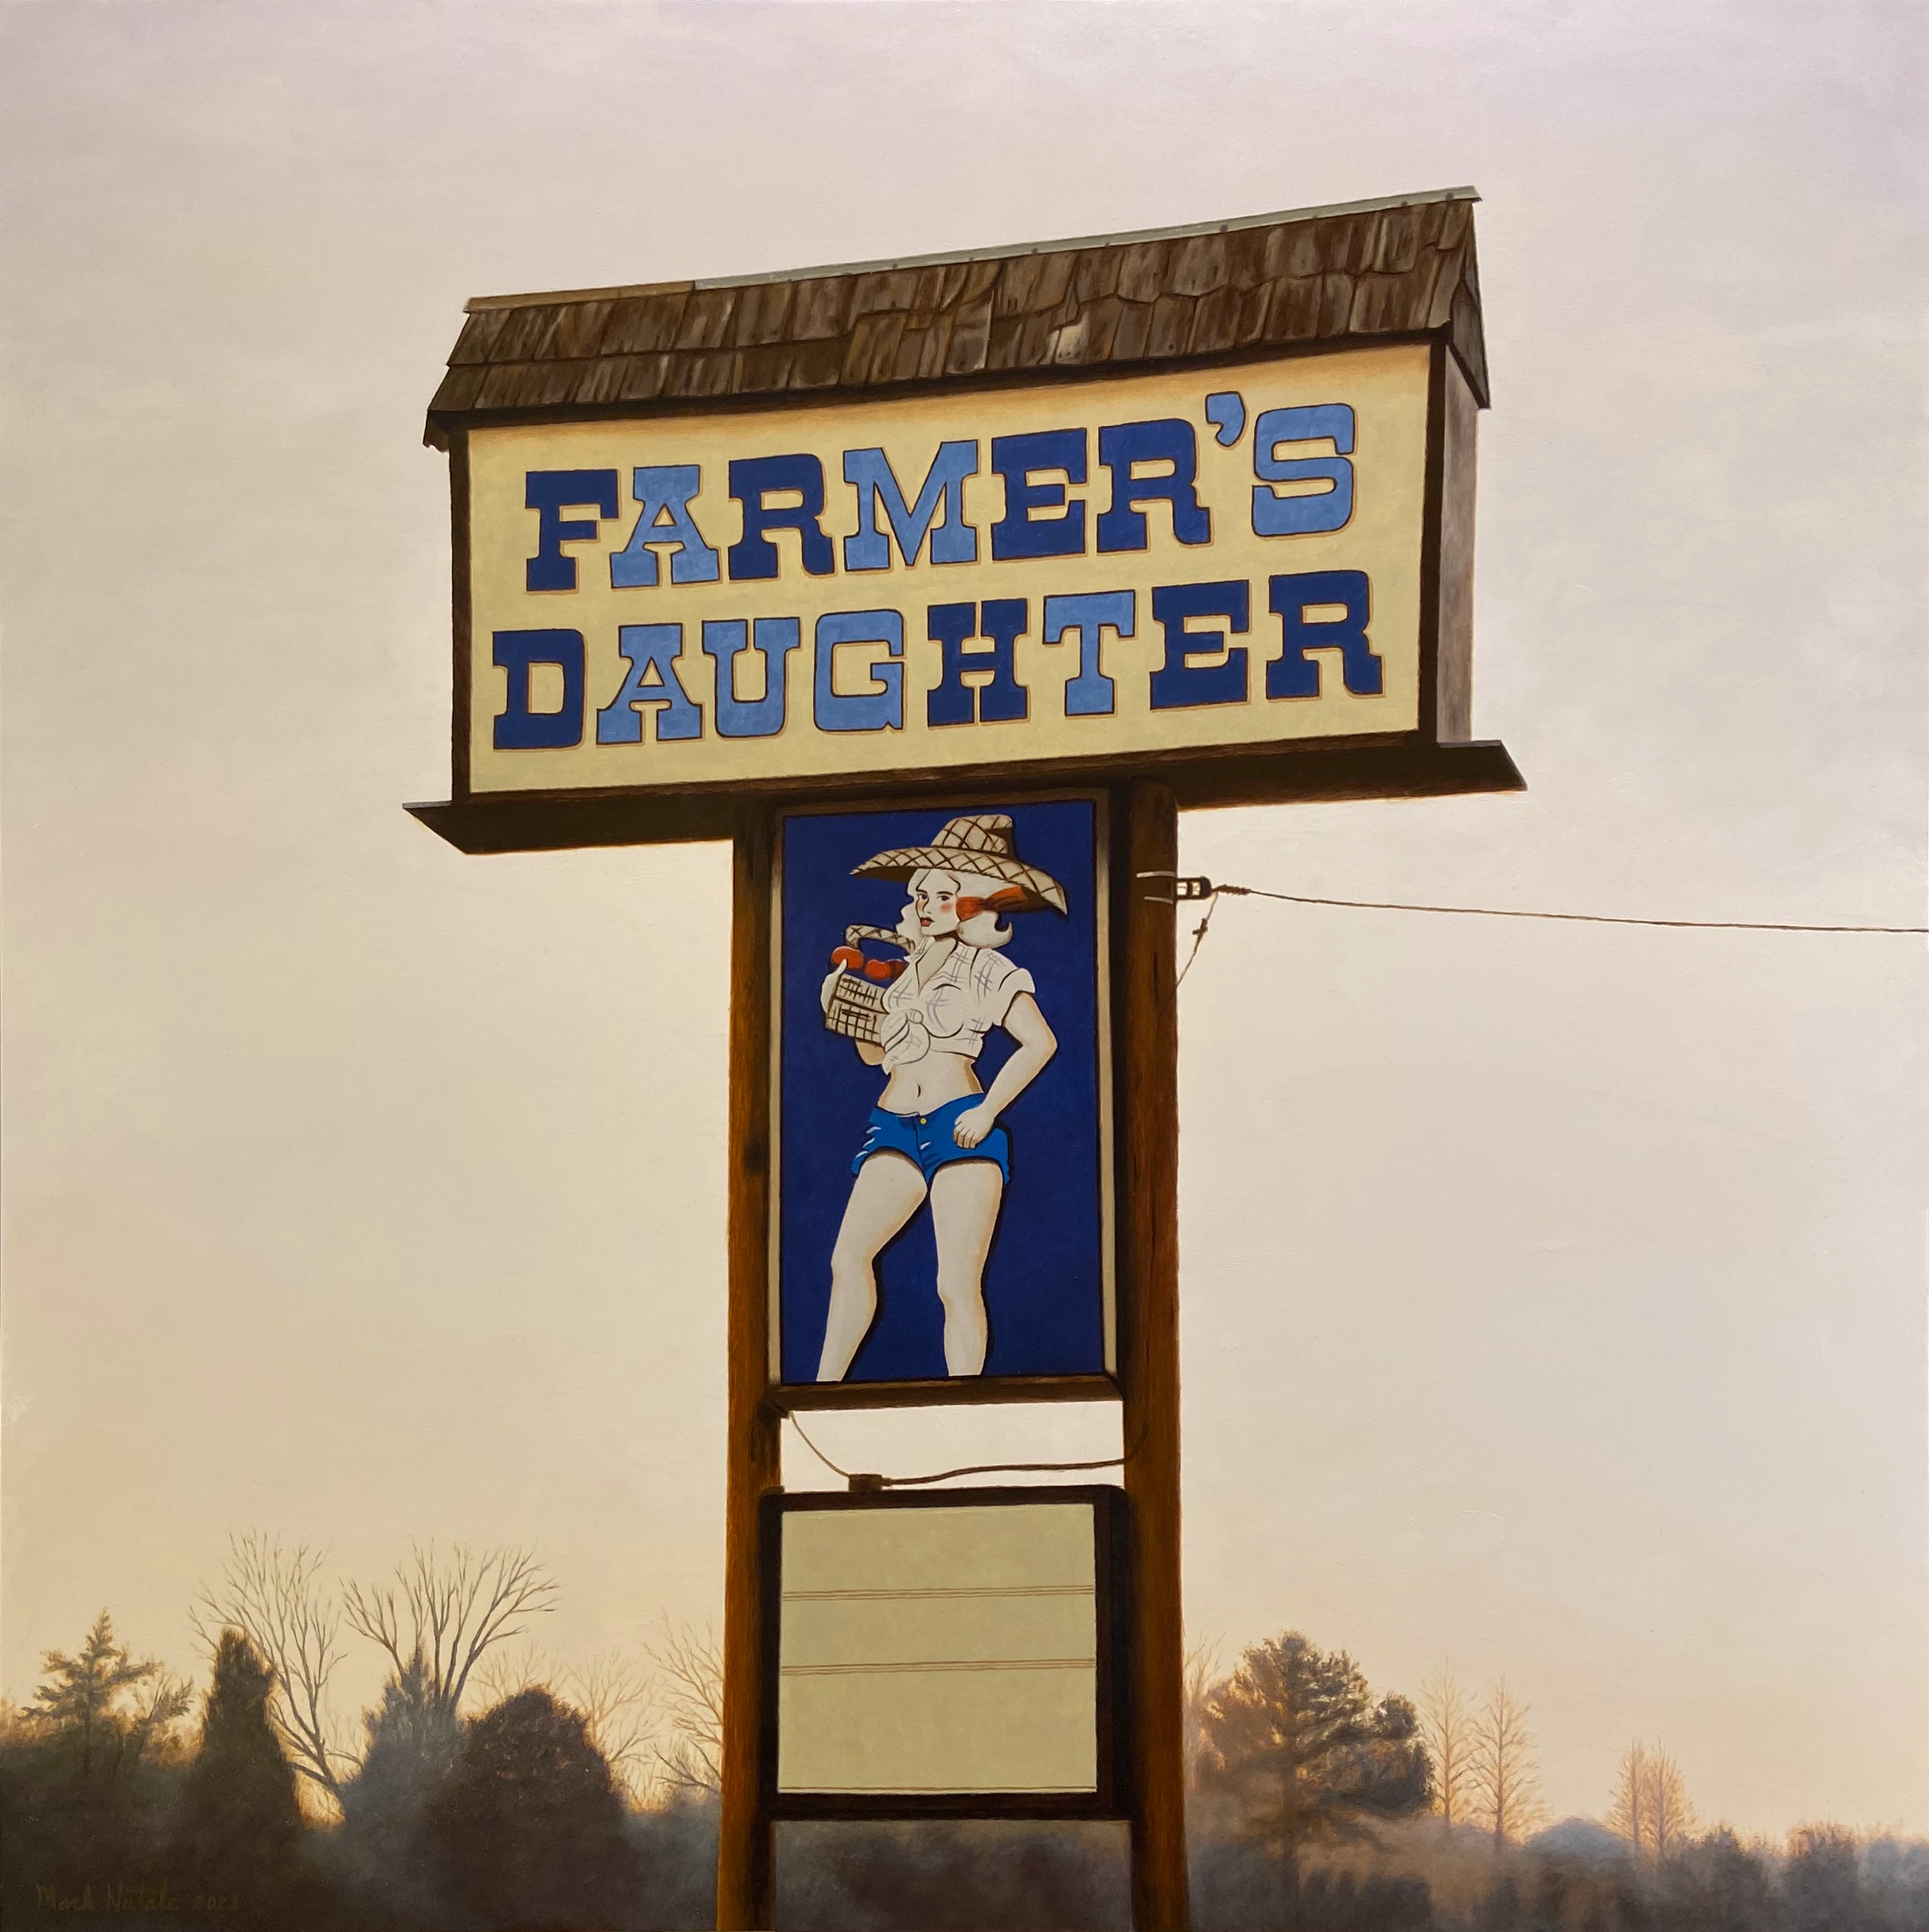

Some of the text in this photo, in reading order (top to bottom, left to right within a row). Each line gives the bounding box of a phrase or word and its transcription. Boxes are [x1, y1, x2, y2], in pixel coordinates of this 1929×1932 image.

[525, 390, 1356, 593] FARMER'S
[492, 569, 1384, 750] DAUGHTER
[35, 1881, 98, 1912] Mark
